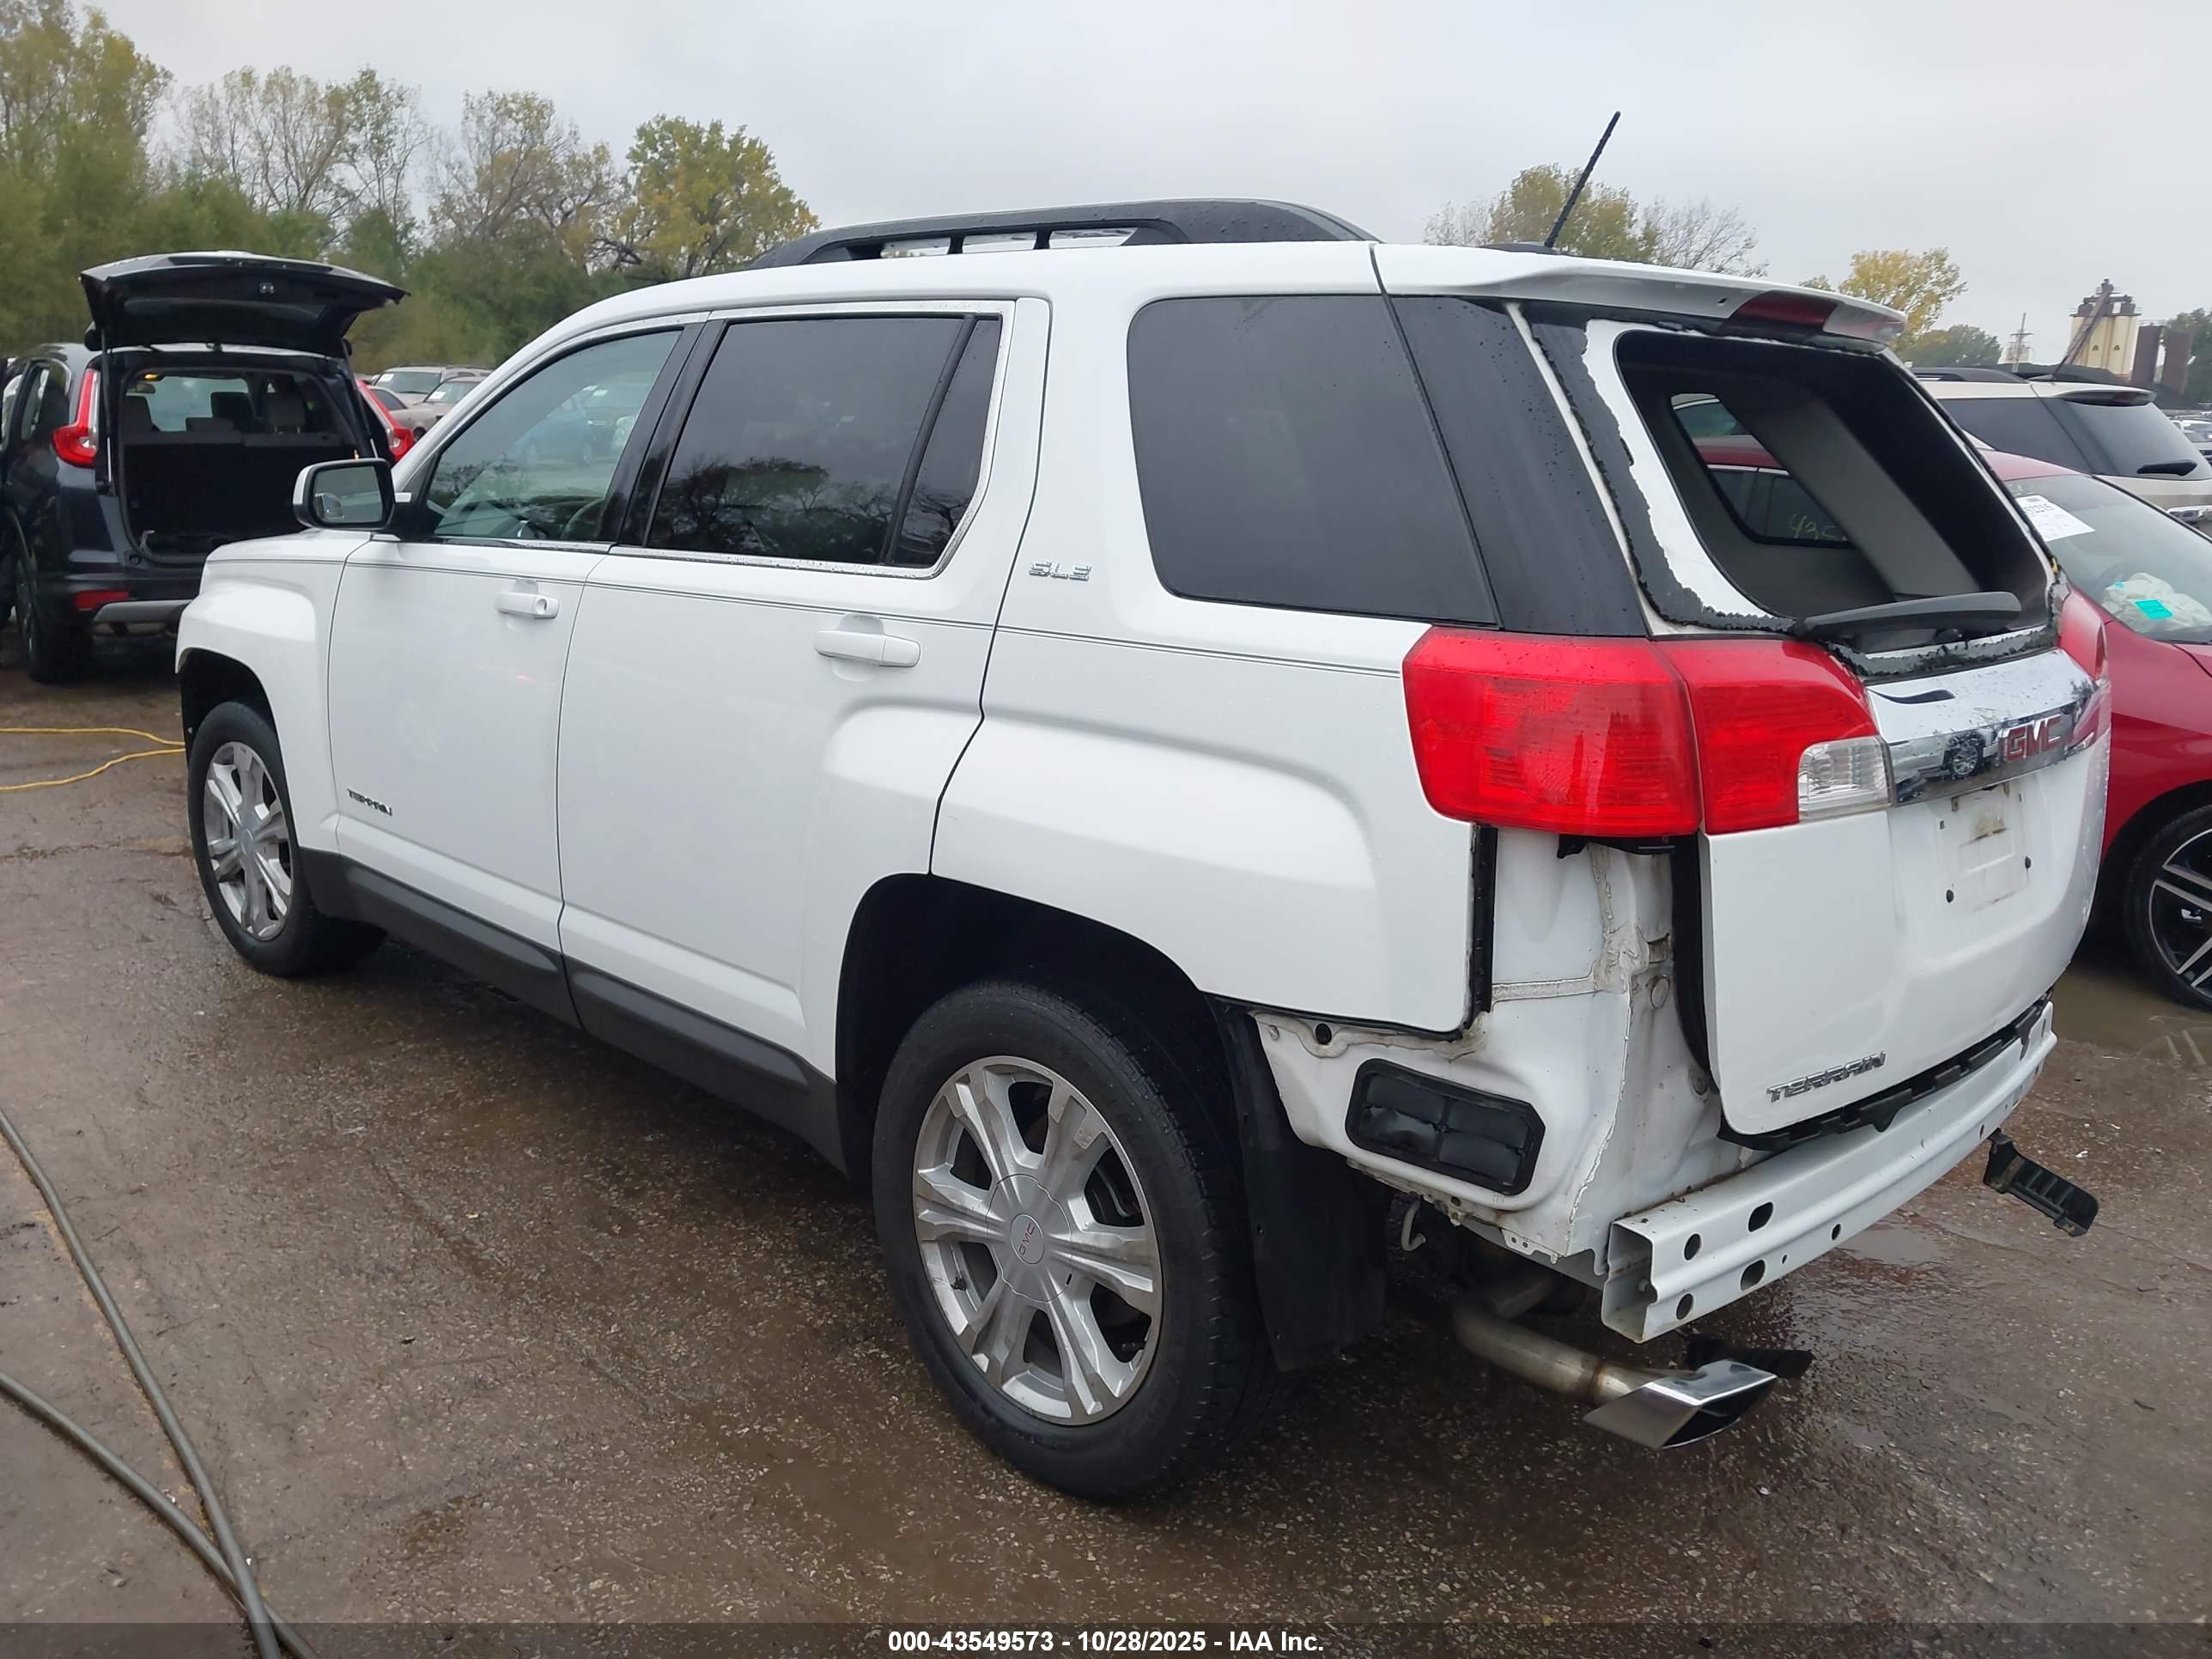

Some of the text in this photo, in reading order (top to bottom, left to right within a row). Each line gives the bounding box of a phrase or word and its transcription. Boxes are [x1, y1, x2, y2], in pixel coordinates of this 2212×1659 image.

[1788, 514, 1848, 541] 435
[1998, 713, 2065, 762] GMC
[1766, 1050, 1887, 1103] TERRAIN
[1018, 1222, 1036, 1255] GMC
